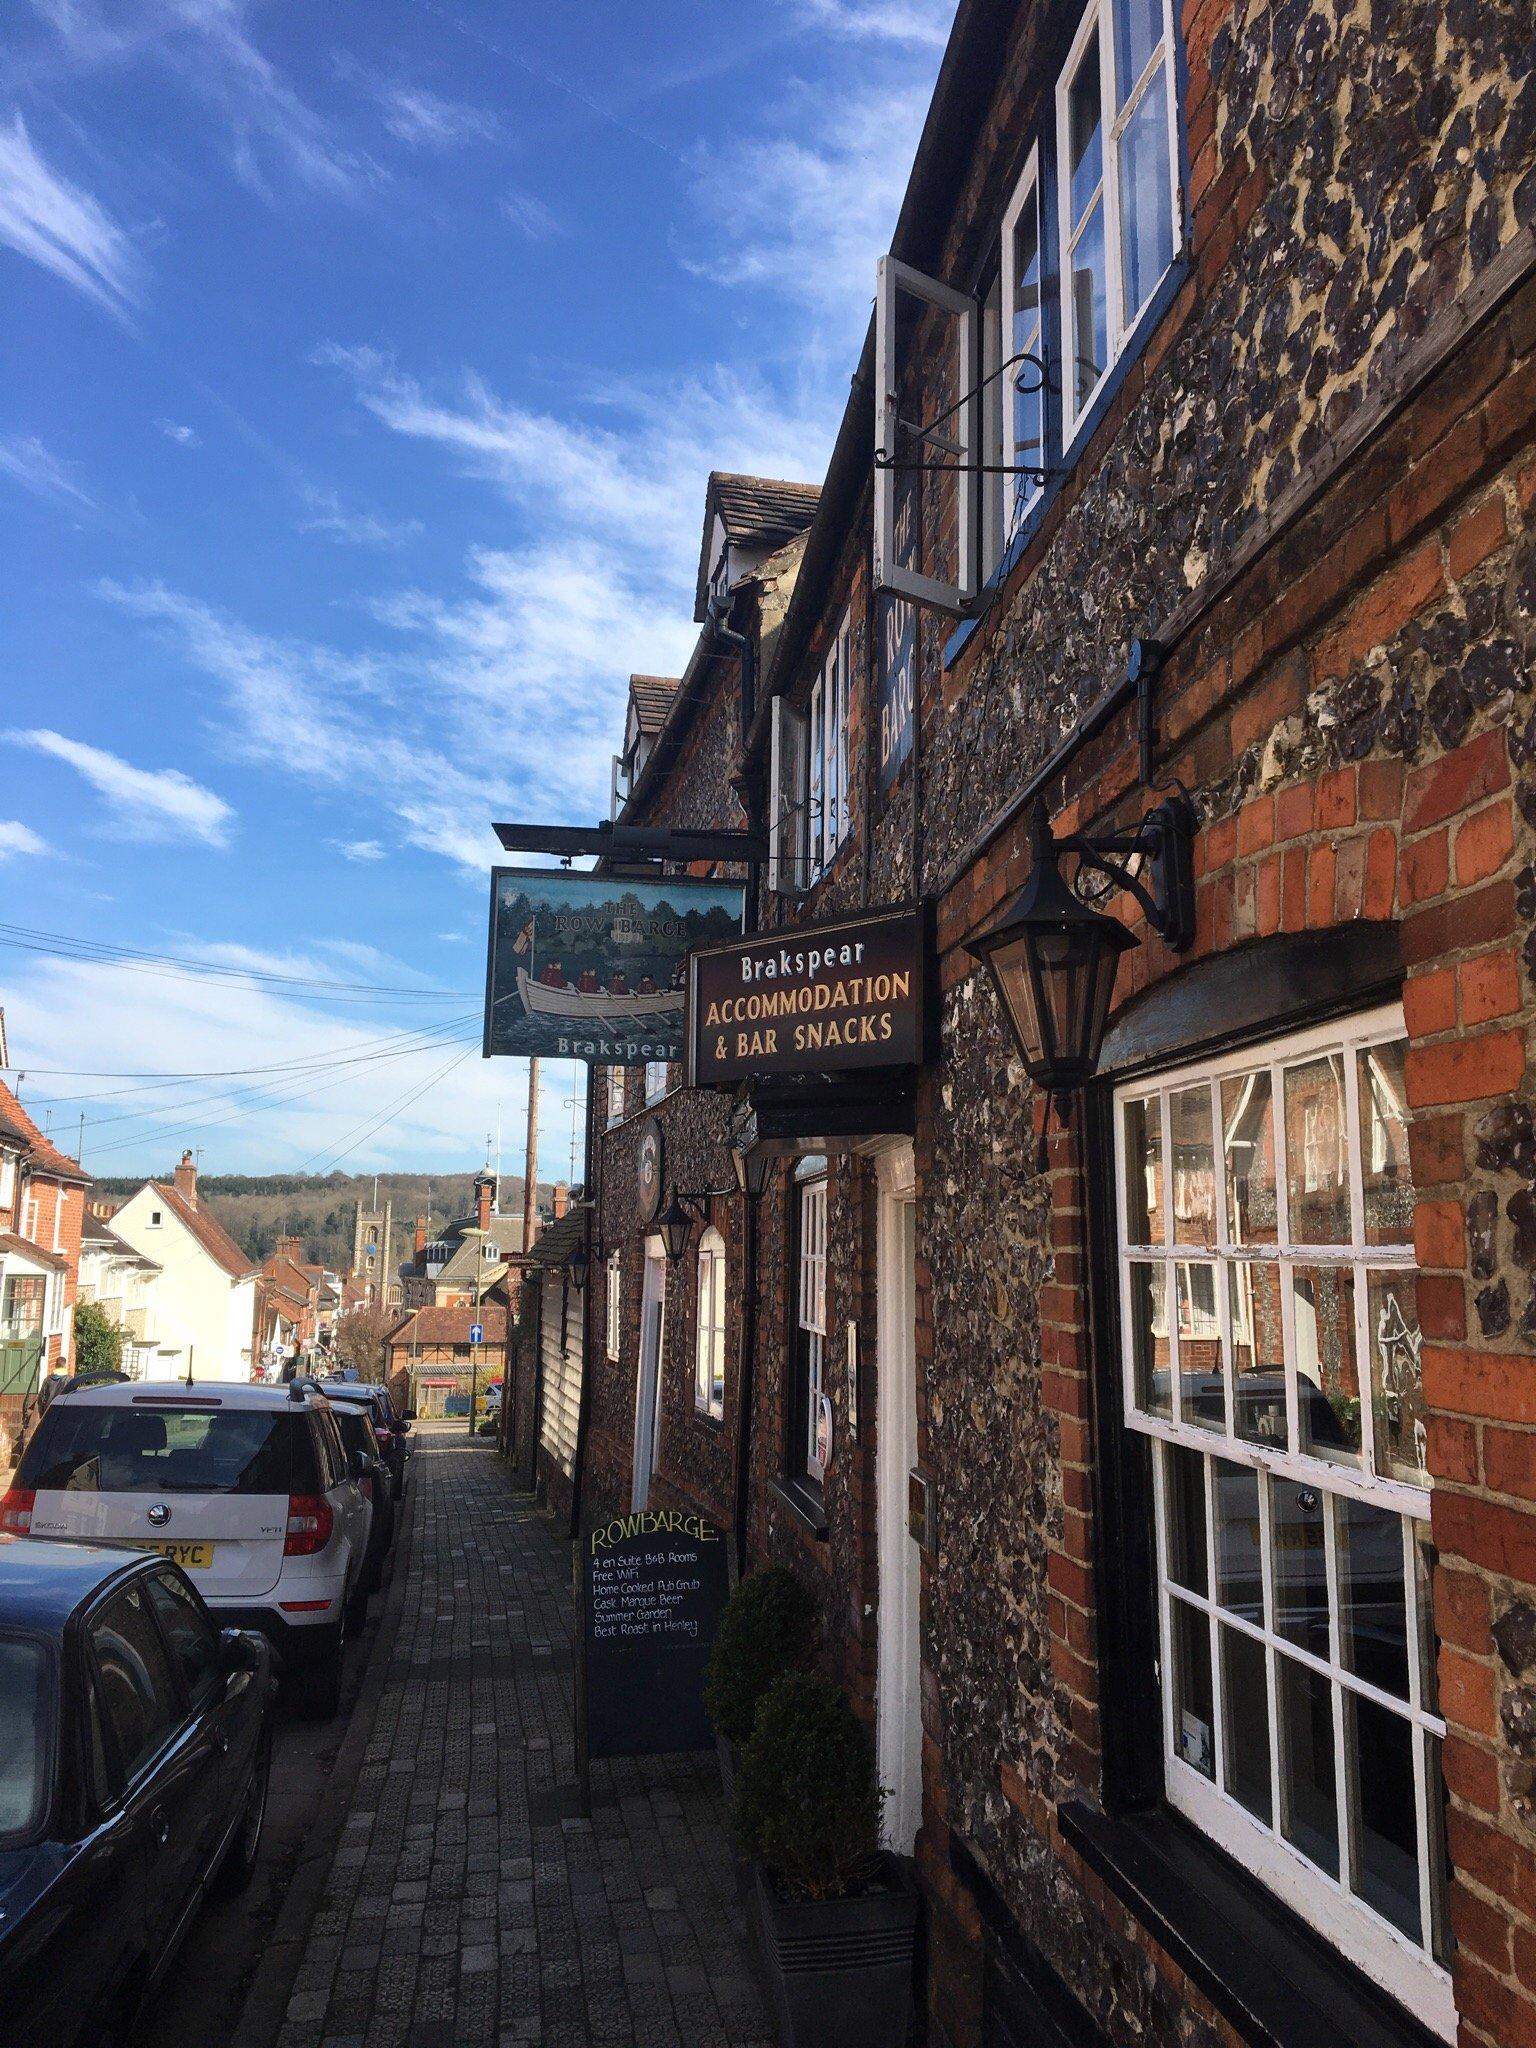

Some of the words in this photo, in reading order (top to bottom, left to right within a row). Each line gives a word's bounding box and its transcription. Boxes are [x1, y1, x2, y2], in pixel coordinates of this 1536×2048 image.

[605, 902, 638, 915] THE
[554, 916, 605, 932] ROW
[619, 919, 687, 937] BARGE
[740, 942, 866, 983] Brakspear
[704, 971, 911, 1027] ACCOMMODATION
[715, 1035, 728, 1060] &
[736, 1029, 779, 1058] BAR
[796, 1012, 893, 1051] SNACKS
[557, 1037, 678, 1060] Brakspear
[591, 1511, 719, 1555] ROWBARGE
[593, 1558, 600, 1569] 4
[602, 1558, 616, 1568] en
[617, 1555, 643, 1567] Suite
[668, 1552, 698, 1563] Rooms
[592, 1571, 614, 1582] Free
[593, 1584, 619, 1596] Home
[621, 1582, 654, 1594] Cooked
[657, 1580, 675, 1591] Pub
[675, 1579, 700, 1590] Grub
[593, 1598, 617, 1610] Cask
[621, 1596, 657, 1609] Marque
[660, 1594, 684, 1605] Beer
[594, 1612, 635, 1623] Summer
[636, 1608, 673, 1620] Garden
[594, 1625, 618, 1637] Best
[620, 1622, 650, 1635] Roast
[652, 1622, 662, 1632] in
[664, 1620, 699, 1637] Henley
